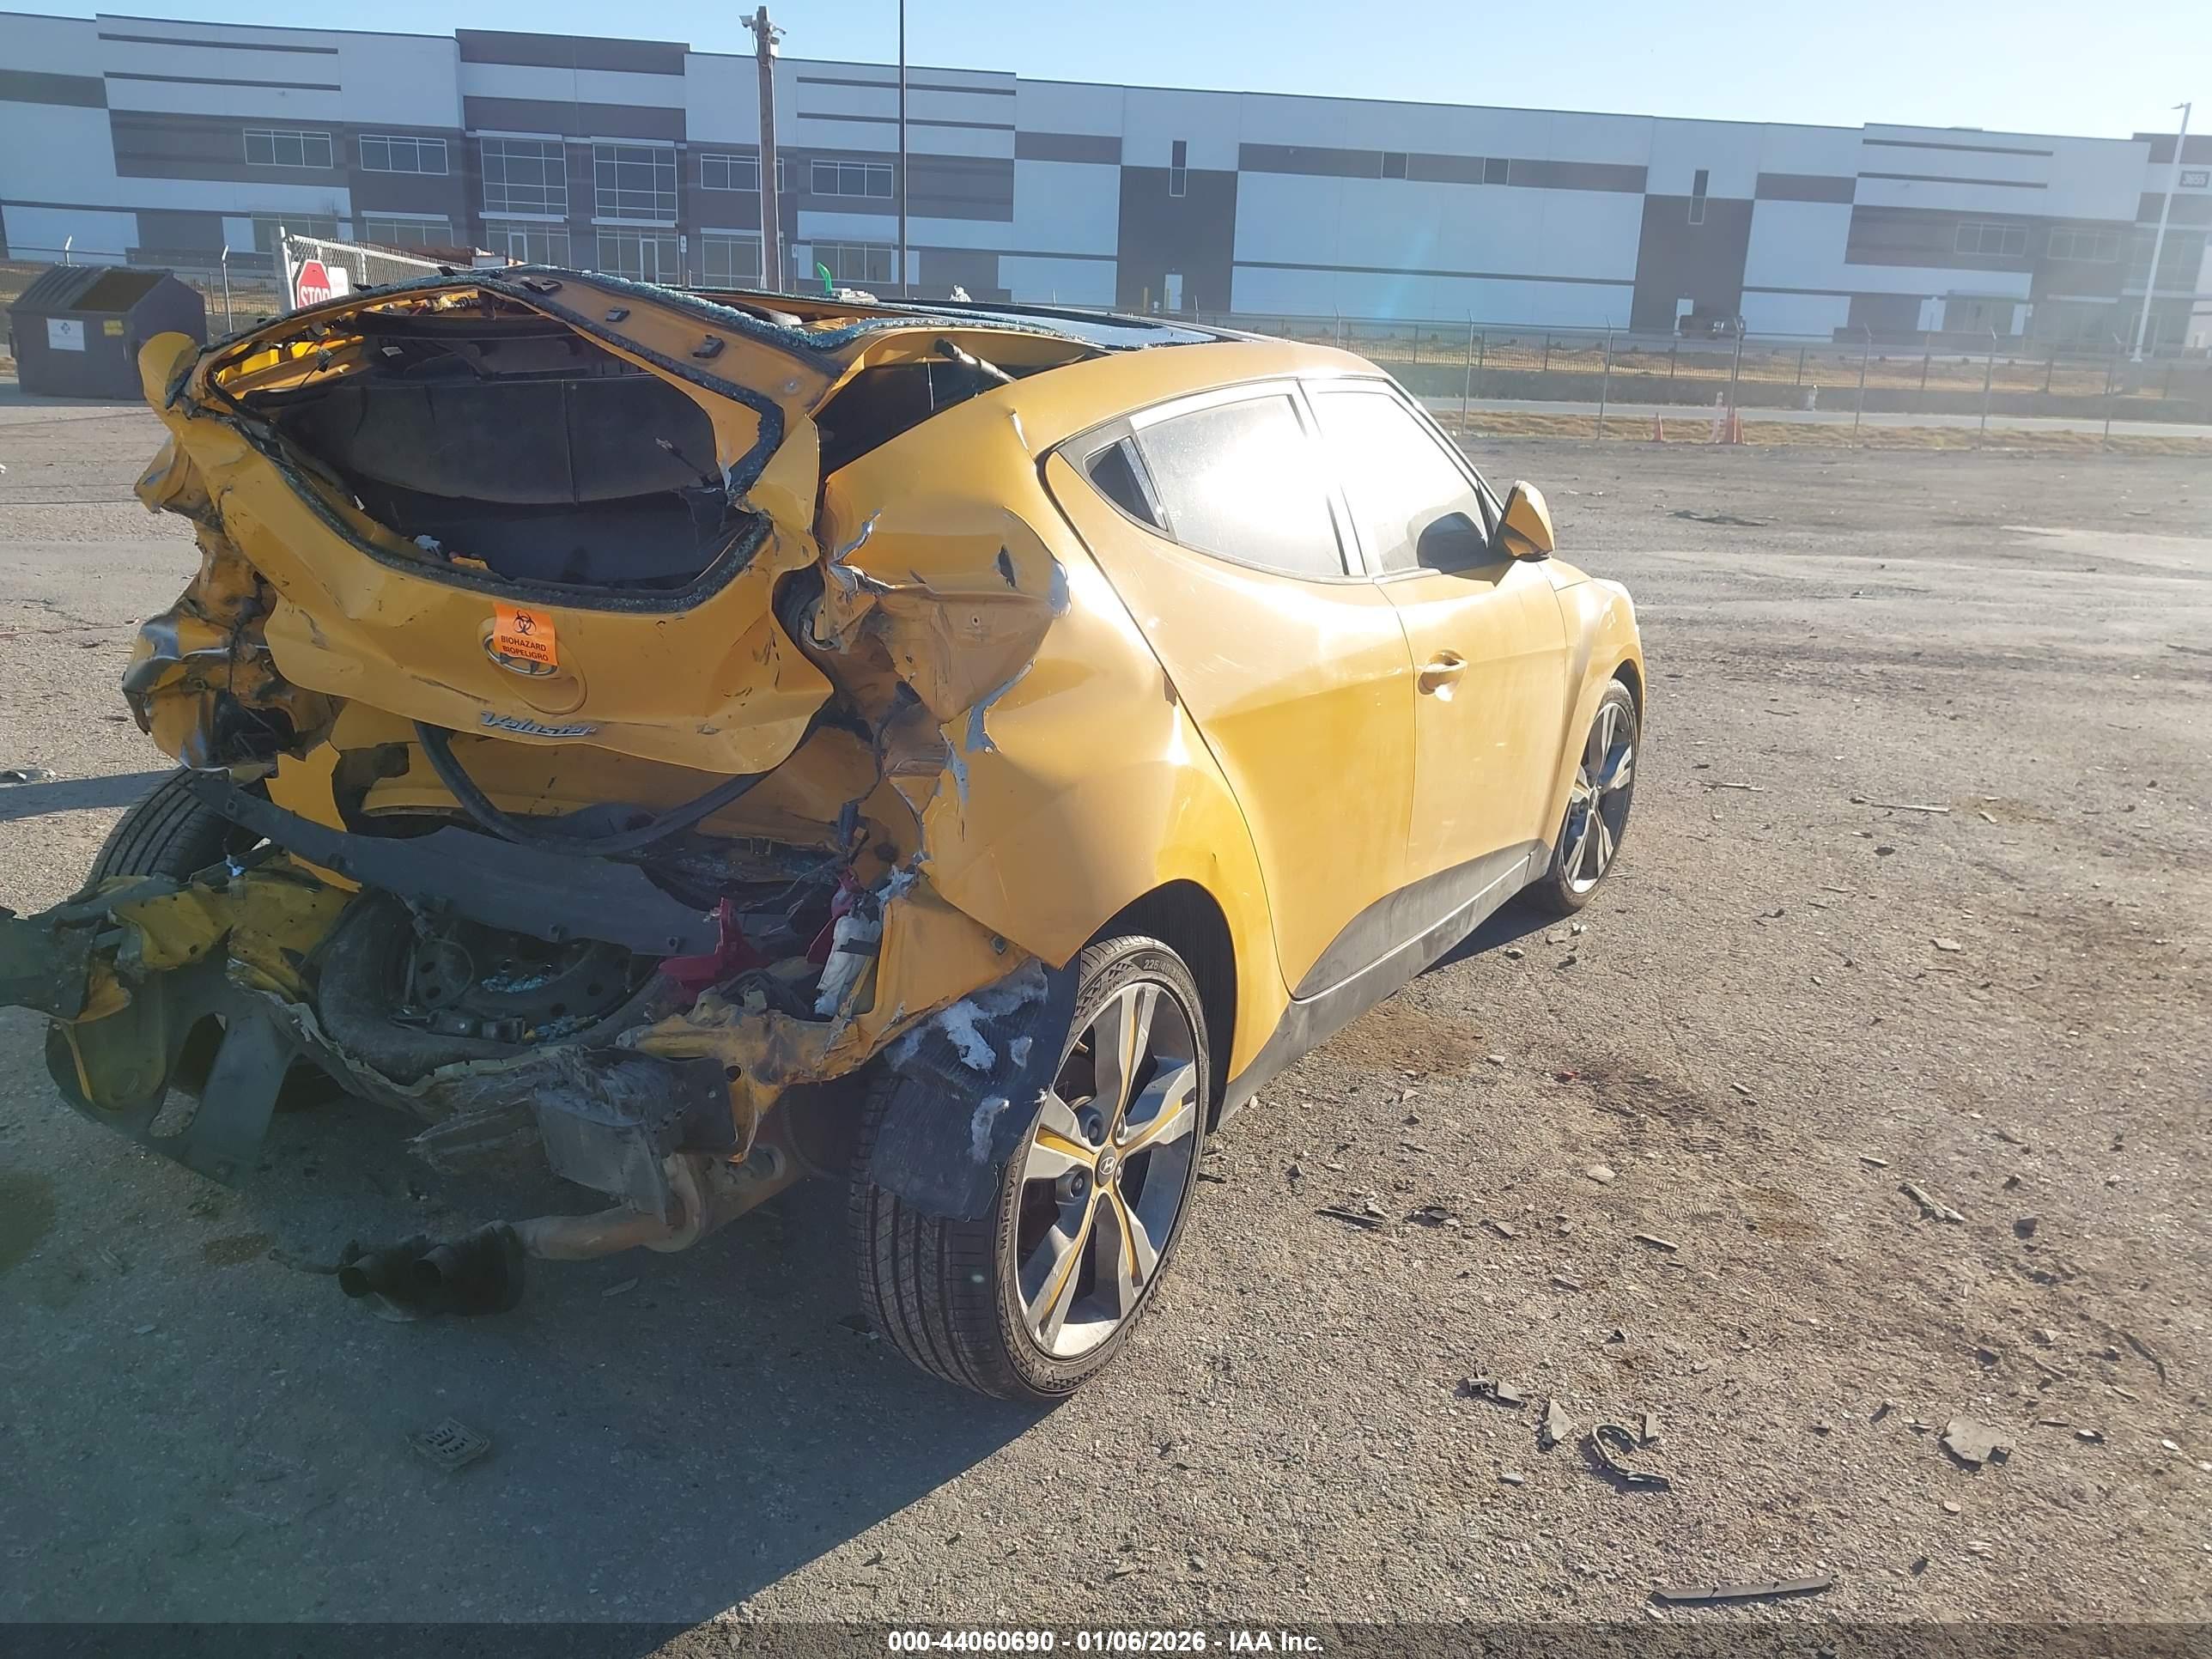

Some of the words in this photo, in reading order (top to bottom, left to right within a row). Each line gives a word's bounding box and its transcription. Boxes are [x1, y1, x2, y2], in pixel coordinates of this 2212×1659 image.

[501, 635, 547, 652] BIOHAZARD
[502, 646, 549, 661] BIOPELIGRO
[480, 710, 598, 737] Veloster
